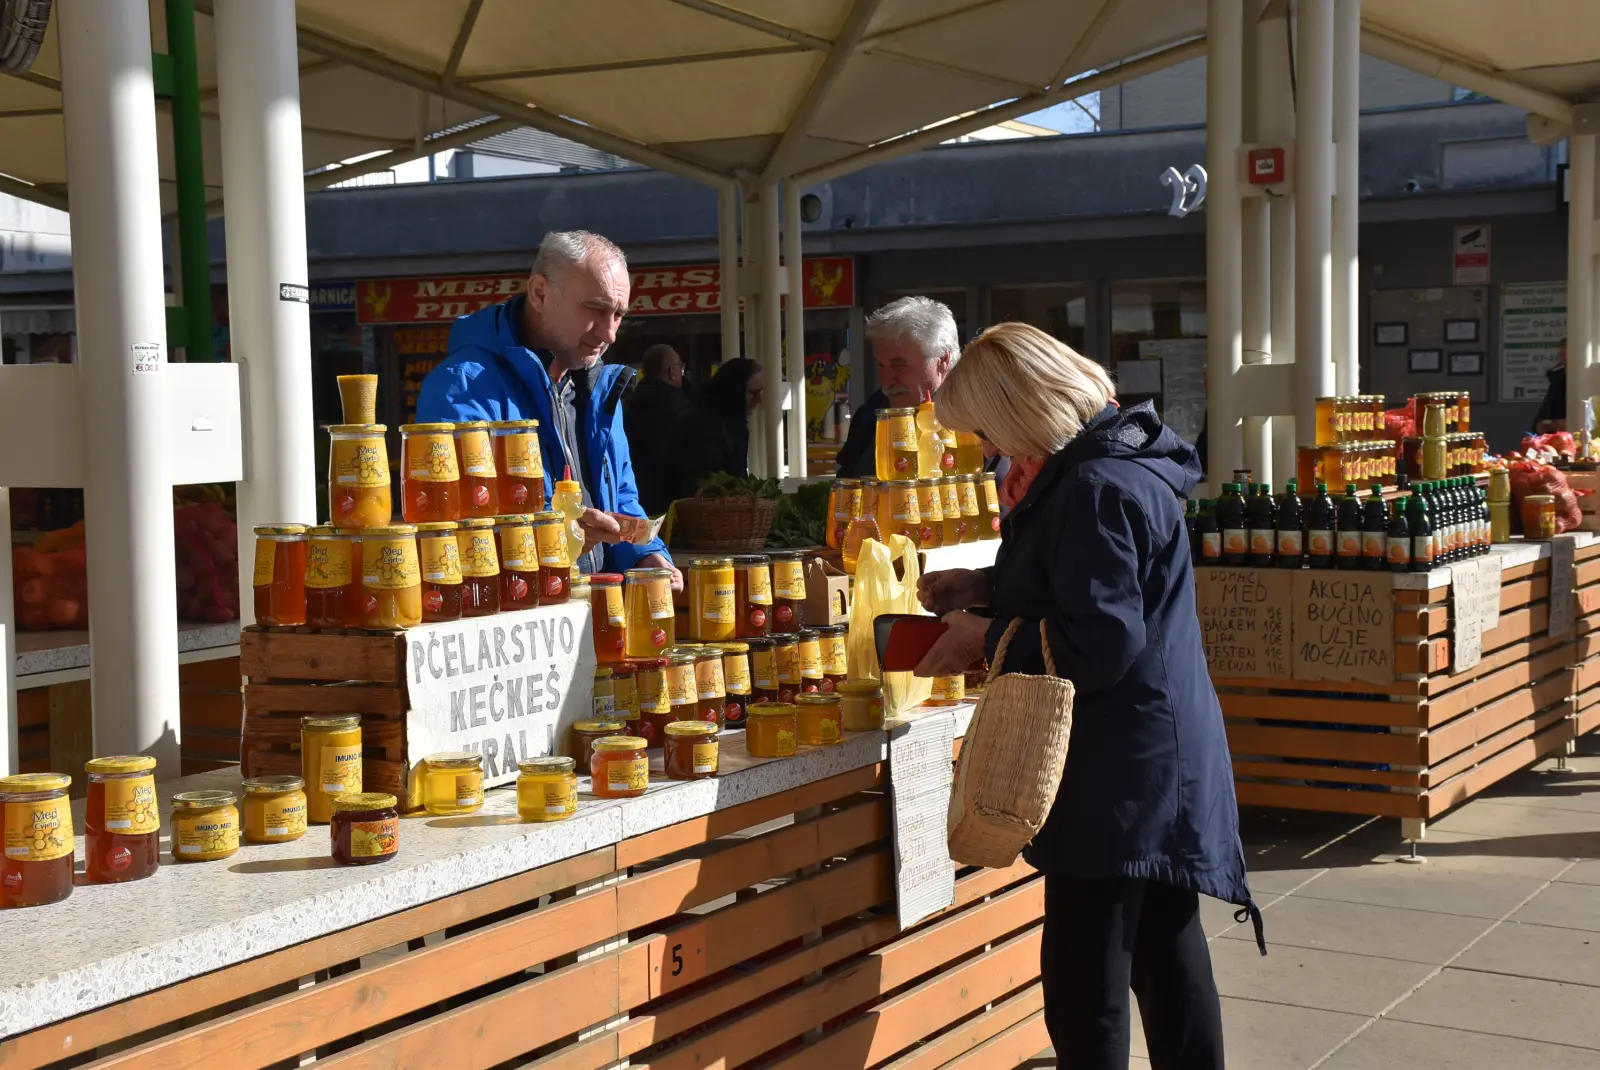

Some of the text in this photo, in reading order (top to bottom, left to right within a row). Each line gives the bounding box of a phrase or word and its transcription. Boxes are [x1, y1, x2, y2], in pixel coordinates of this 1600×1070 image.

[1222, 584, 1268, 602] MED
[1309, 578, 1375, 603] AKCIJA
[1308, 602, 1383, 626] BUČINO
[1263, 620, 1283, 633] 10€
[1320, 625, 1368, 648] ULJE
[1206, 633, 1283, 645] LIPA 10€
[412, 616, 574, 684] PČELARSTVO
[450, 664, 560, 732] KEČKEŠ
[335, 753, 357, 762] IMUNO
[33, 808, 58, 821] Med
[282, 806, 301, 814] IMUNO
[672, 944, 683, 976] 5
